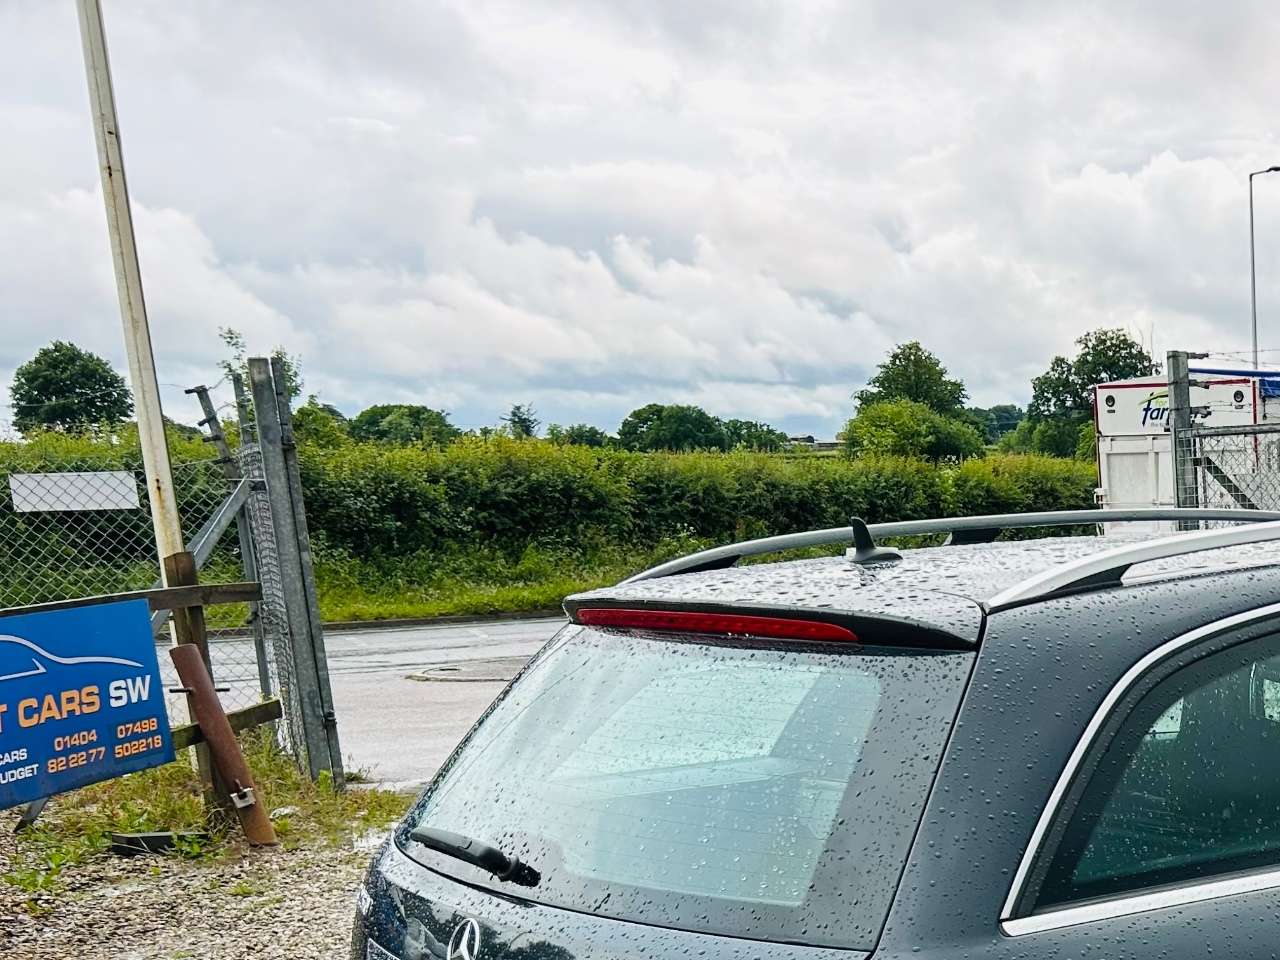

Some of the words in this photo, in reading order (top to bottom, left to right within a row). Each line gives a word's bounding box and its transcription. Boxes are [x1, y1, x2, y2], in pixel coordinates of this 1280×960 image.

[18, 685, 101, 728] CARS
[109, 675, 151, 708] SW
[54, 729, 98, 751] 01404
